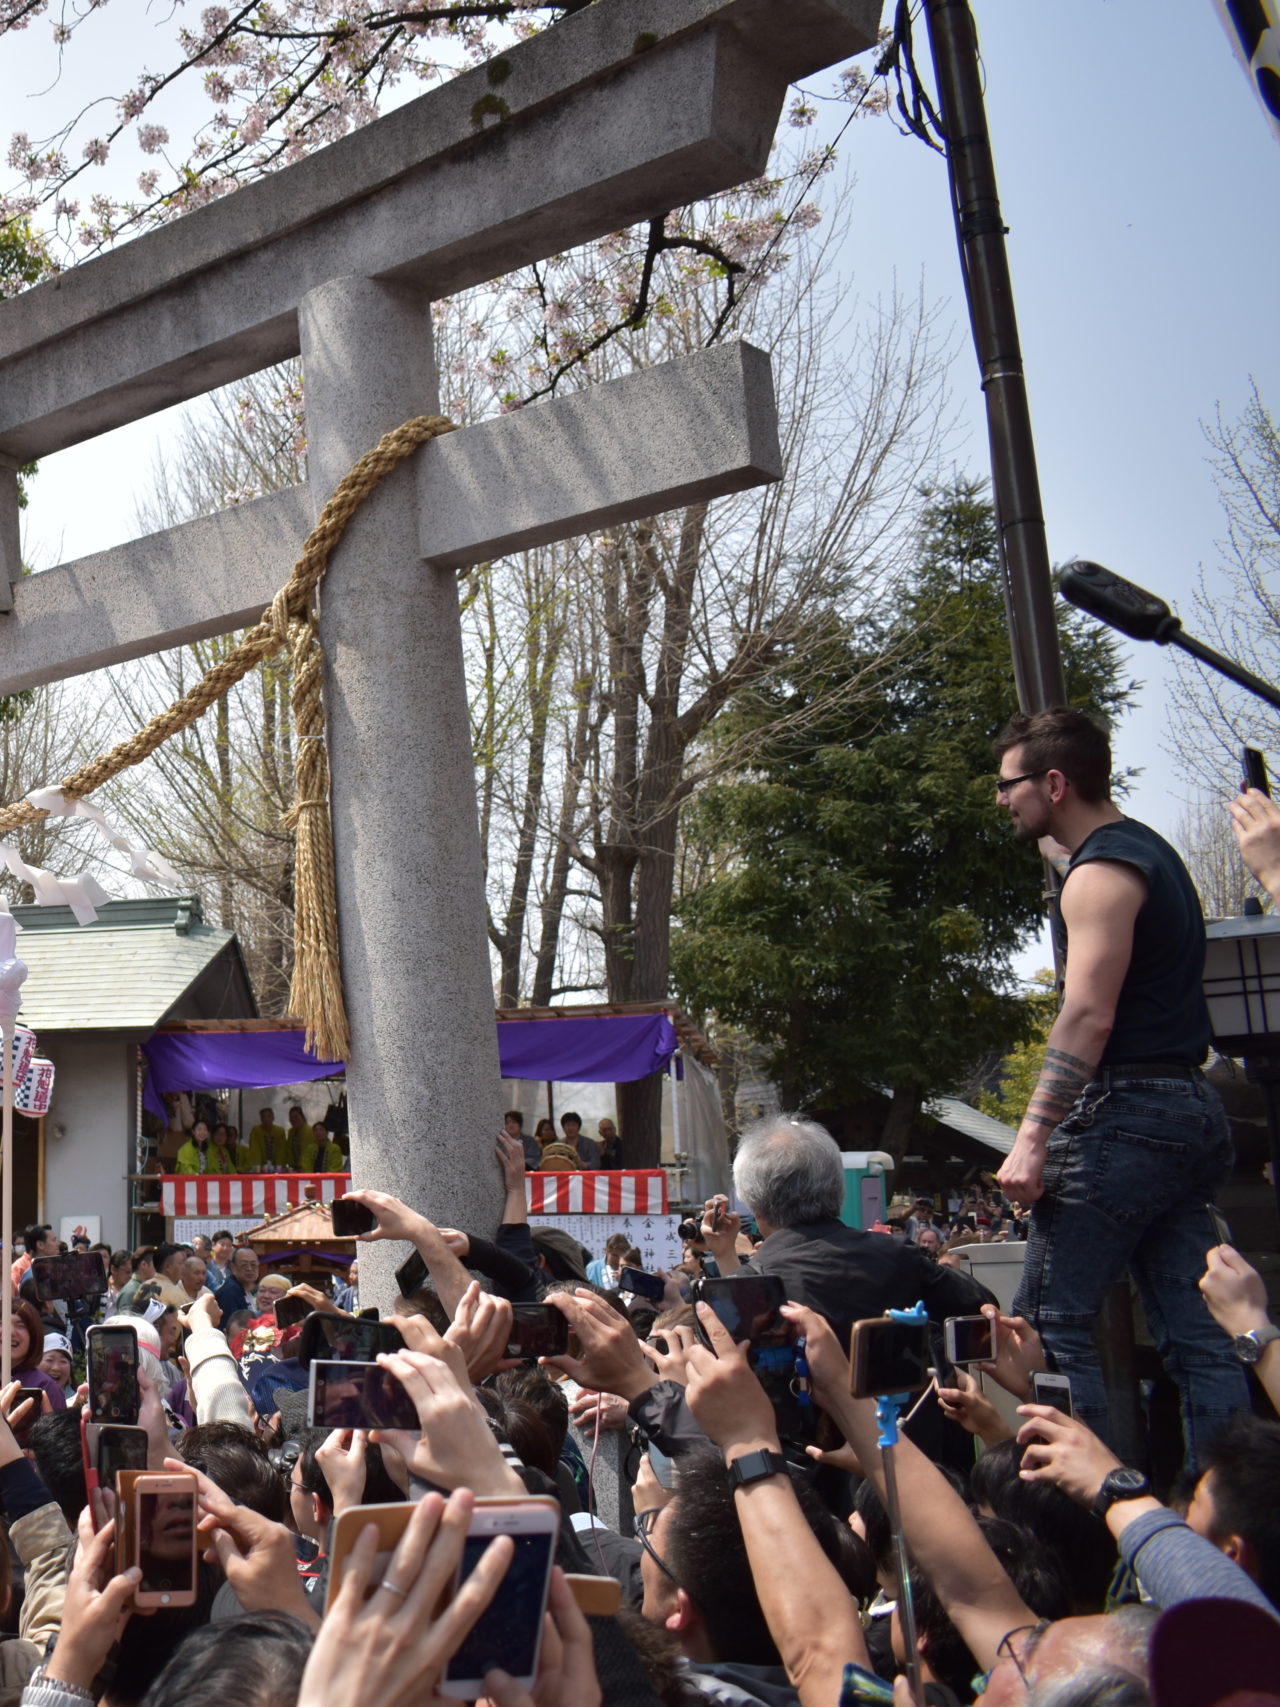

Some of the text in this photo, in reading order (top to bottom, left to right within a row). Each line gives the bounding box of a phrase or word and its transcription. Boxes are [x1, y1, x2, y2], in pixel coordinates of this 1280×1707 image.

[34, 1067, 52, 1111] 花魁道中
[642, 1217, 655, 1272] 金山神社
